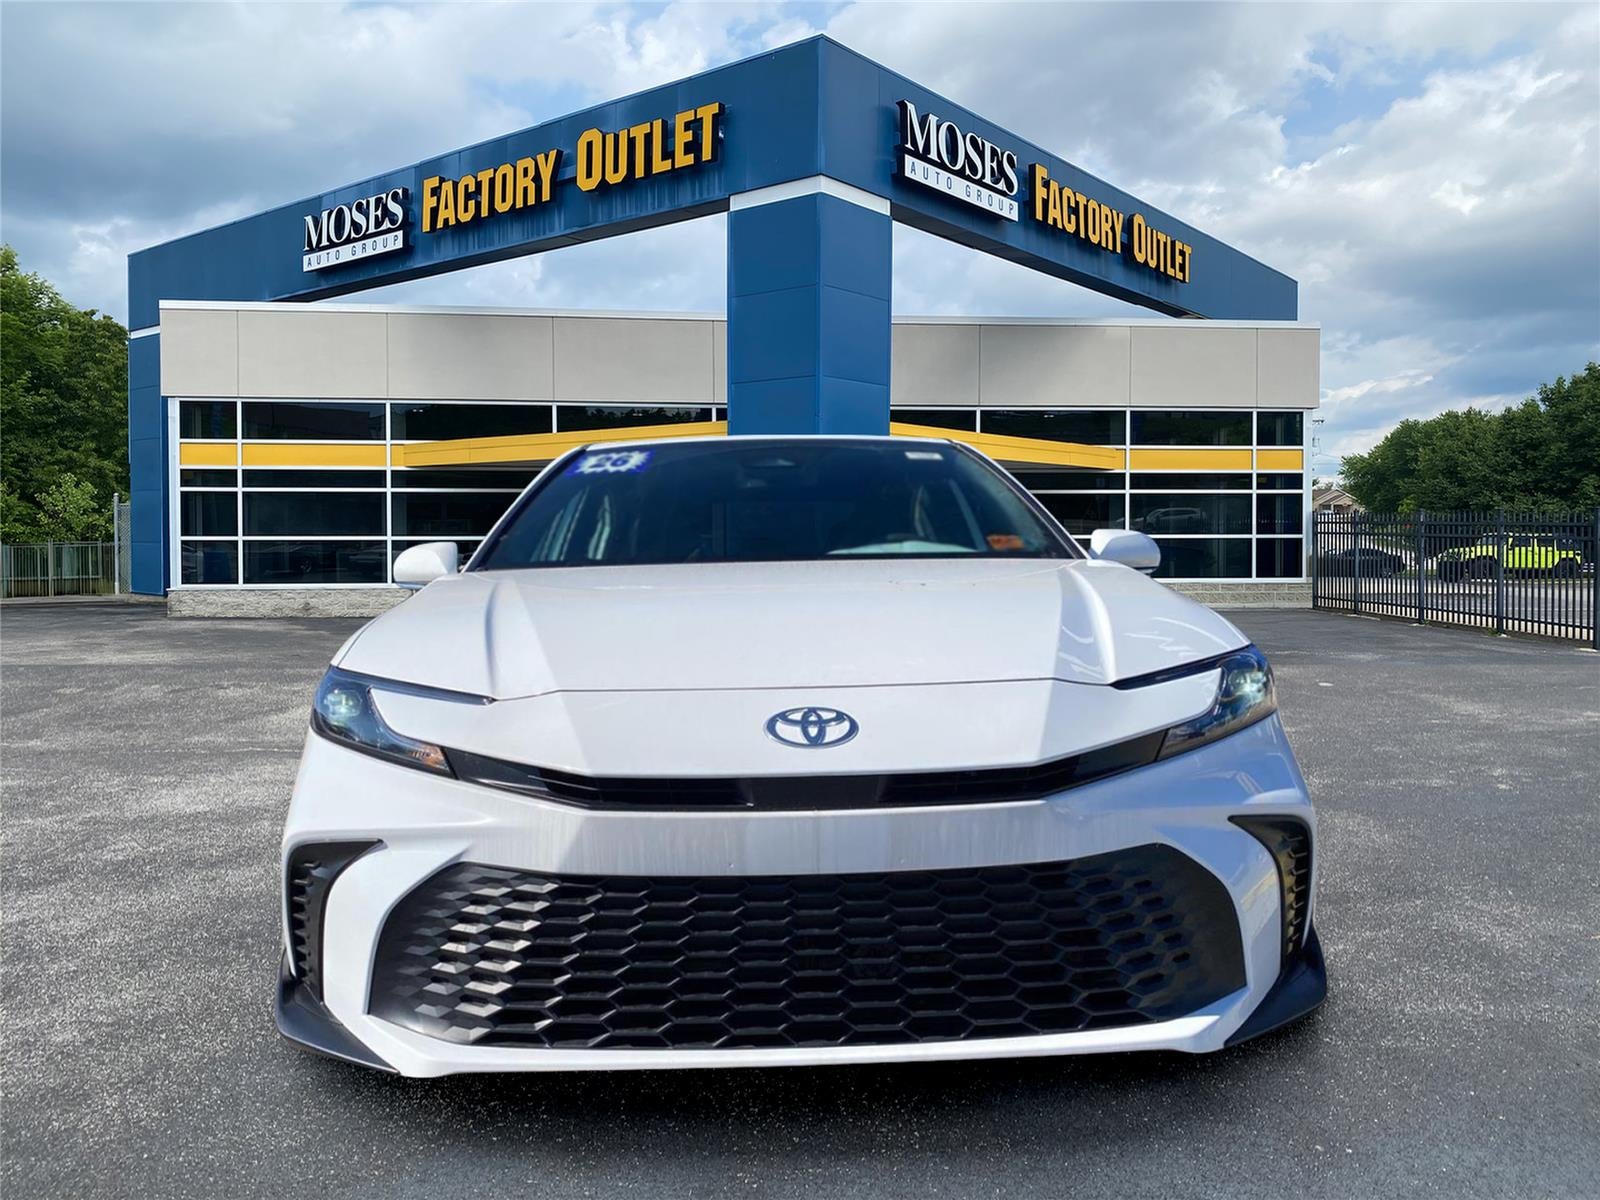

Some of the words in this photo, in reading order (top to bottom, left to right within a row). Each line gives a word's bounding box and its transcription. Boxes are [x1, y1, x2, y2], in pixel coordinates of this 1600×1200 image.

[422, 149, 558, 232] FACTORY
[576, 102, 720, 192] OUTLET
[903, 99, 1018, 196] MOSES
[910, 161, 953, 190] AUTO
[964, 184, 1014, 215] GROUP
[303, 187, 404, 252] MOSES
[307, 249, 340, 268] AUTO
[351, 234, 399, 257] GROUP
[1034, 163, 1124, 254] FACTORY
[1133, 213, 1193, 283] OUTLET
